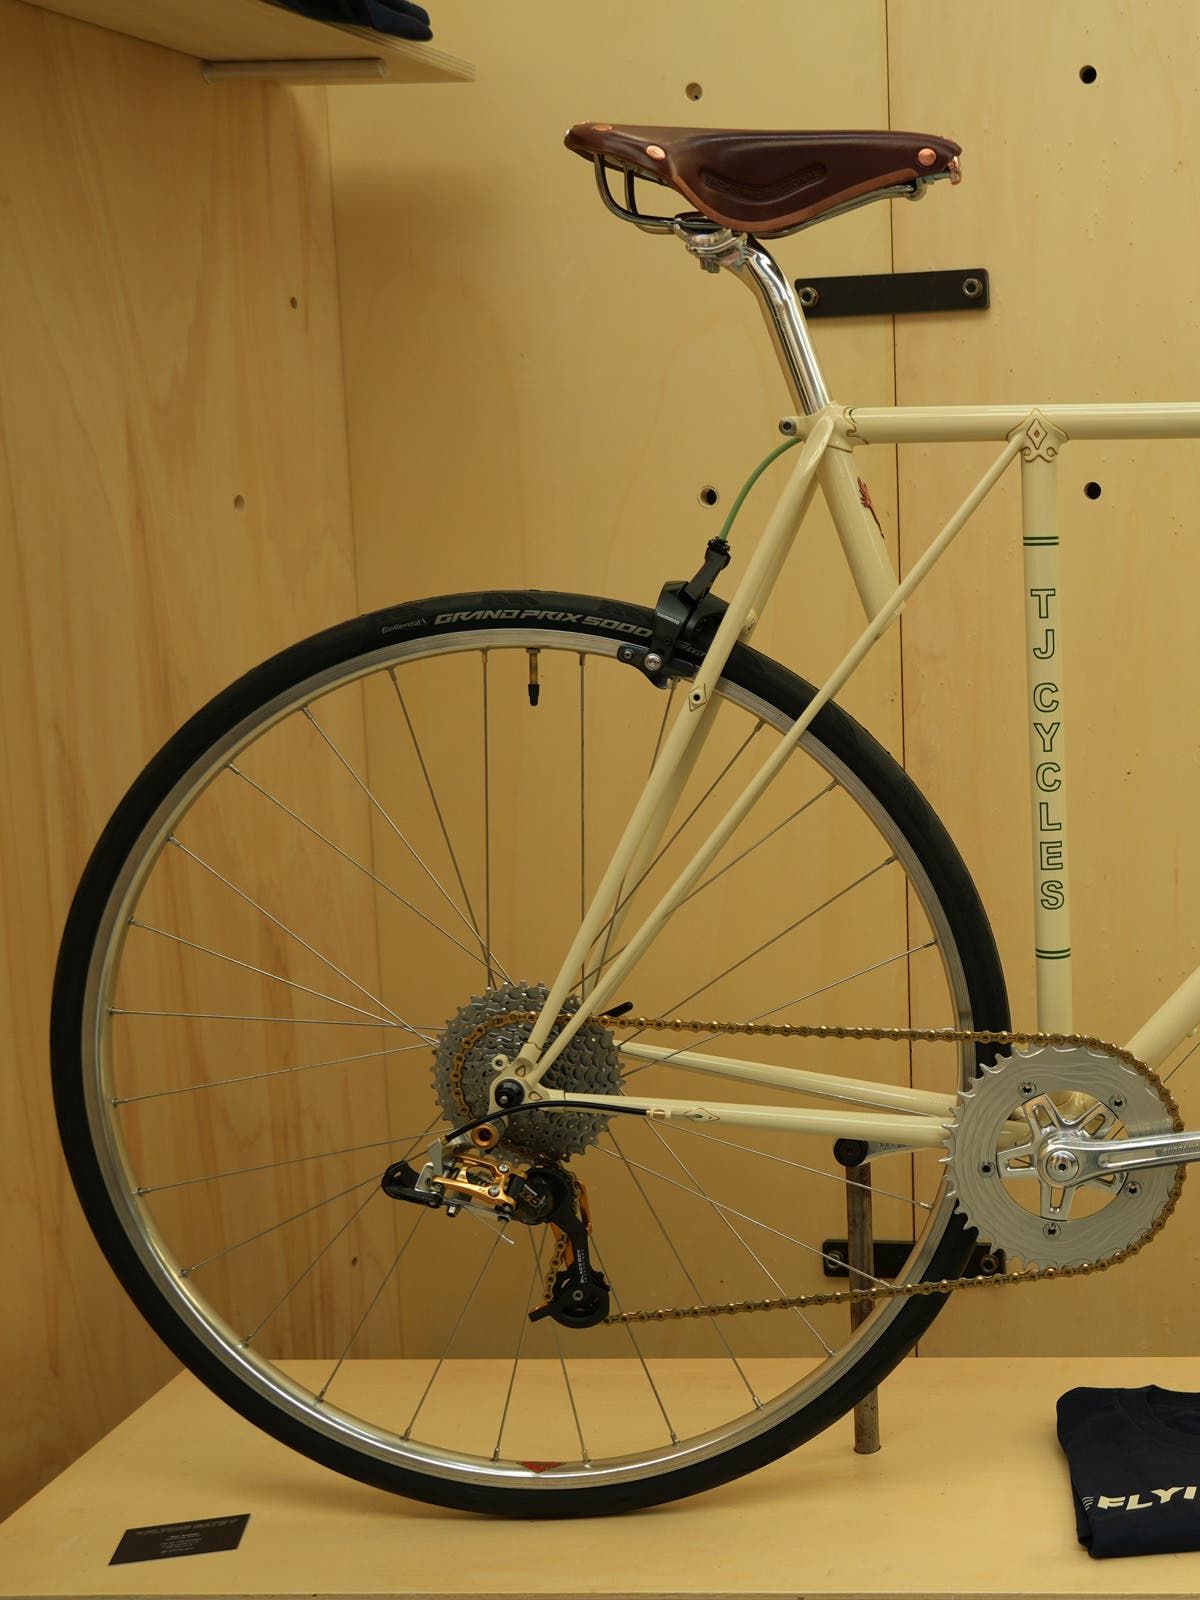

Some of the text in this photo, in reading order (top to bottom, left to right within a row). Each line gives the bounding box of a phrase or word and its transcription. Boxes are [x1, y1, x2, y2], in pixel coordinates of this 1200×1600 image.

[433, 609, 654, 638] GRAND PRIX 5000
[1030, 588, 1065, 910] TJ CYCLES
